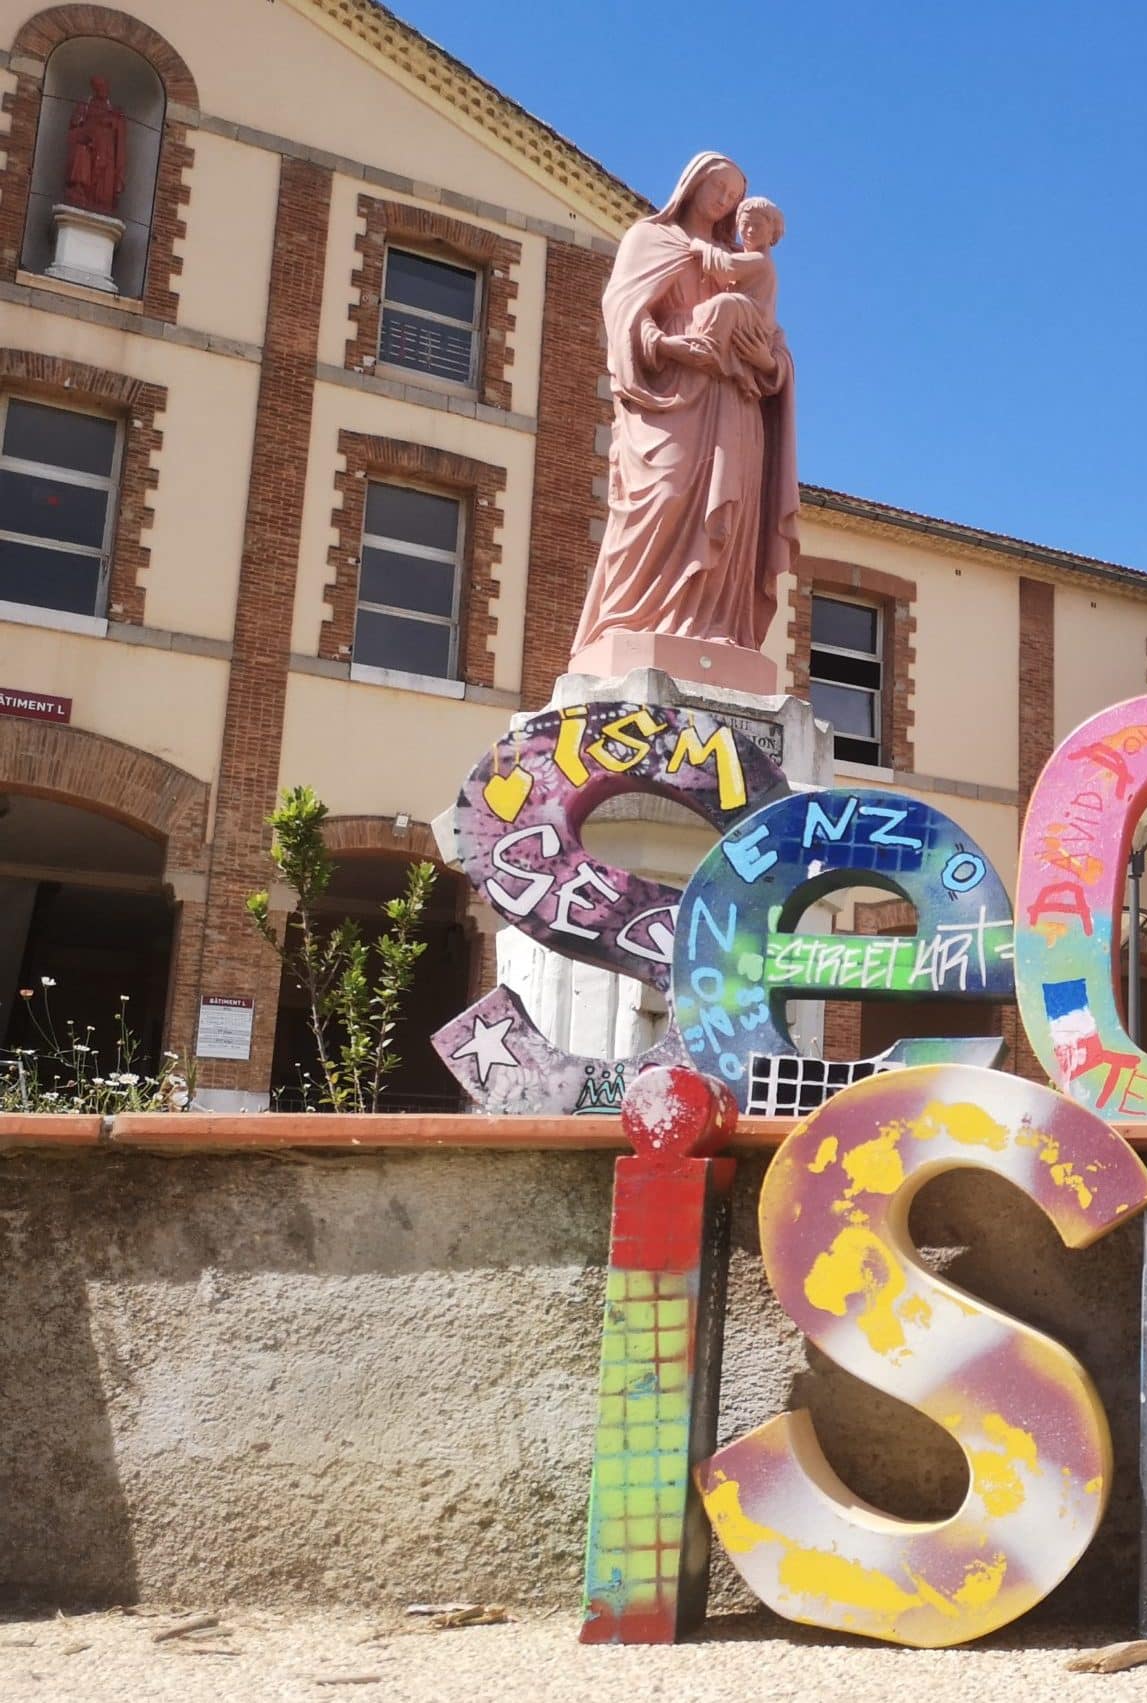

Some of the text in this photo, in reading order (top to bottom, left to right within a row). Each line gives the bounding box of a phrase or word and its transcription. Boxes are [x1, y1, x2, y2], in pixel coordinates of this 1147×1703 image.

[57, 705, 65, 715] L
[723, 796, 986, 894] ENZO
[767, 906, 1014, 990] STREET ART
